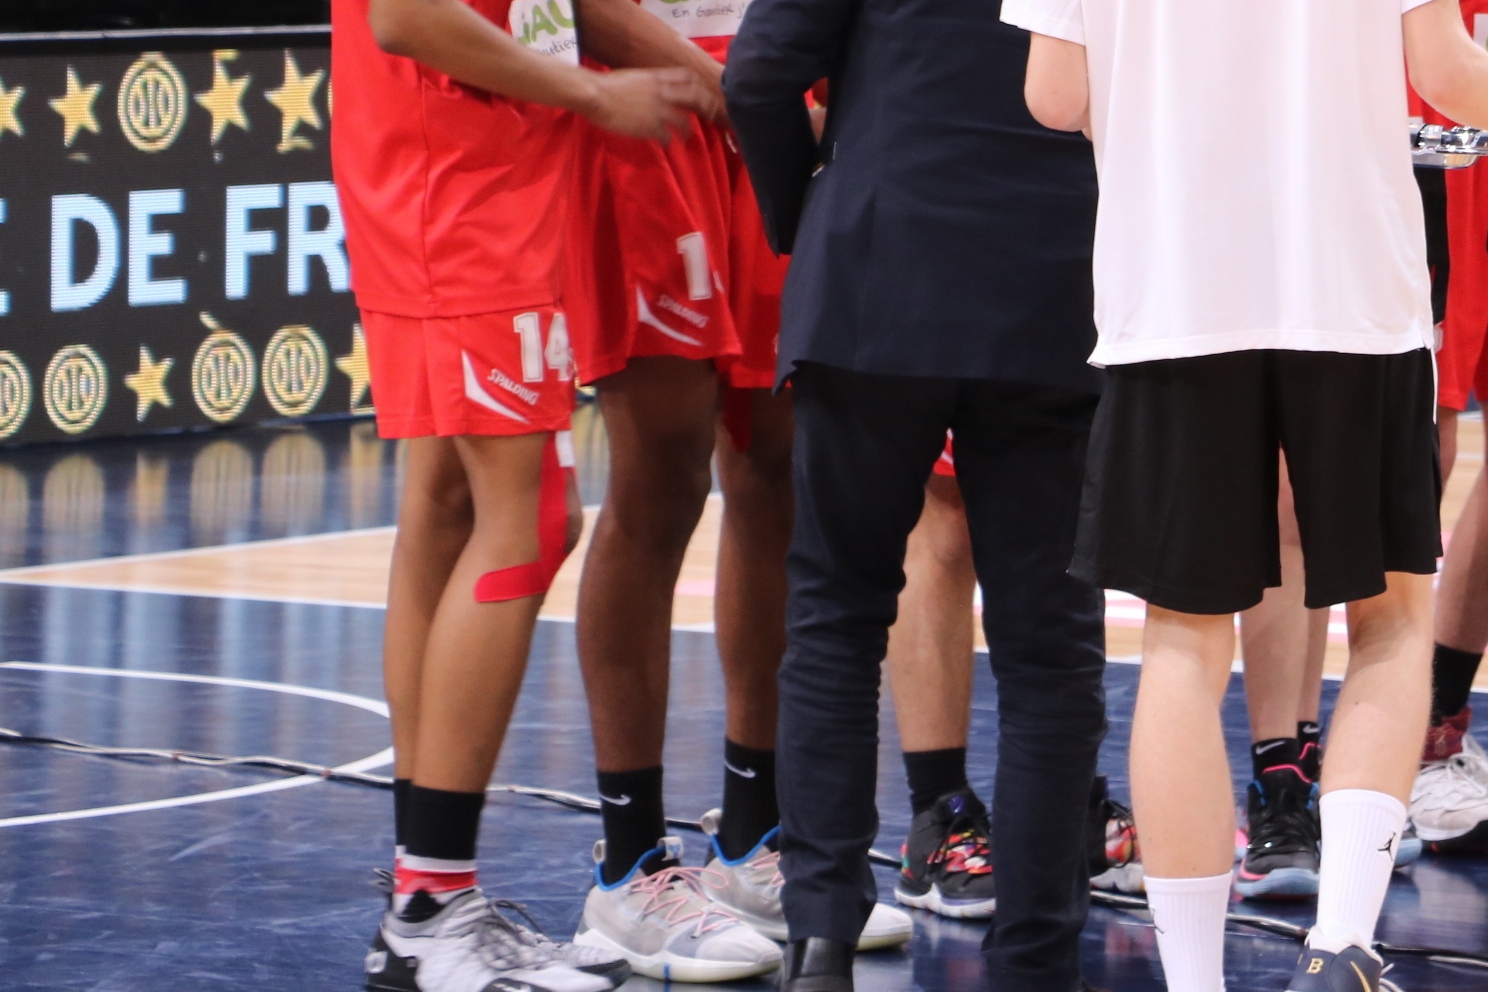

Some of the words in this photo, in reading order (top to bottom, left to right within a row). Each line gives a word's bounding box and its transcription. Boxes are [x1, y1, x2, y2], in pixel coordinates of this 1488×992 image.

[51, 188, 188, 313] DE
[225, 180, 353, 300] FR
[513, 311, 573, 382] 14
[487, 368, 540, 406] SPALDING
[1305, 957, 1325, 975] B
